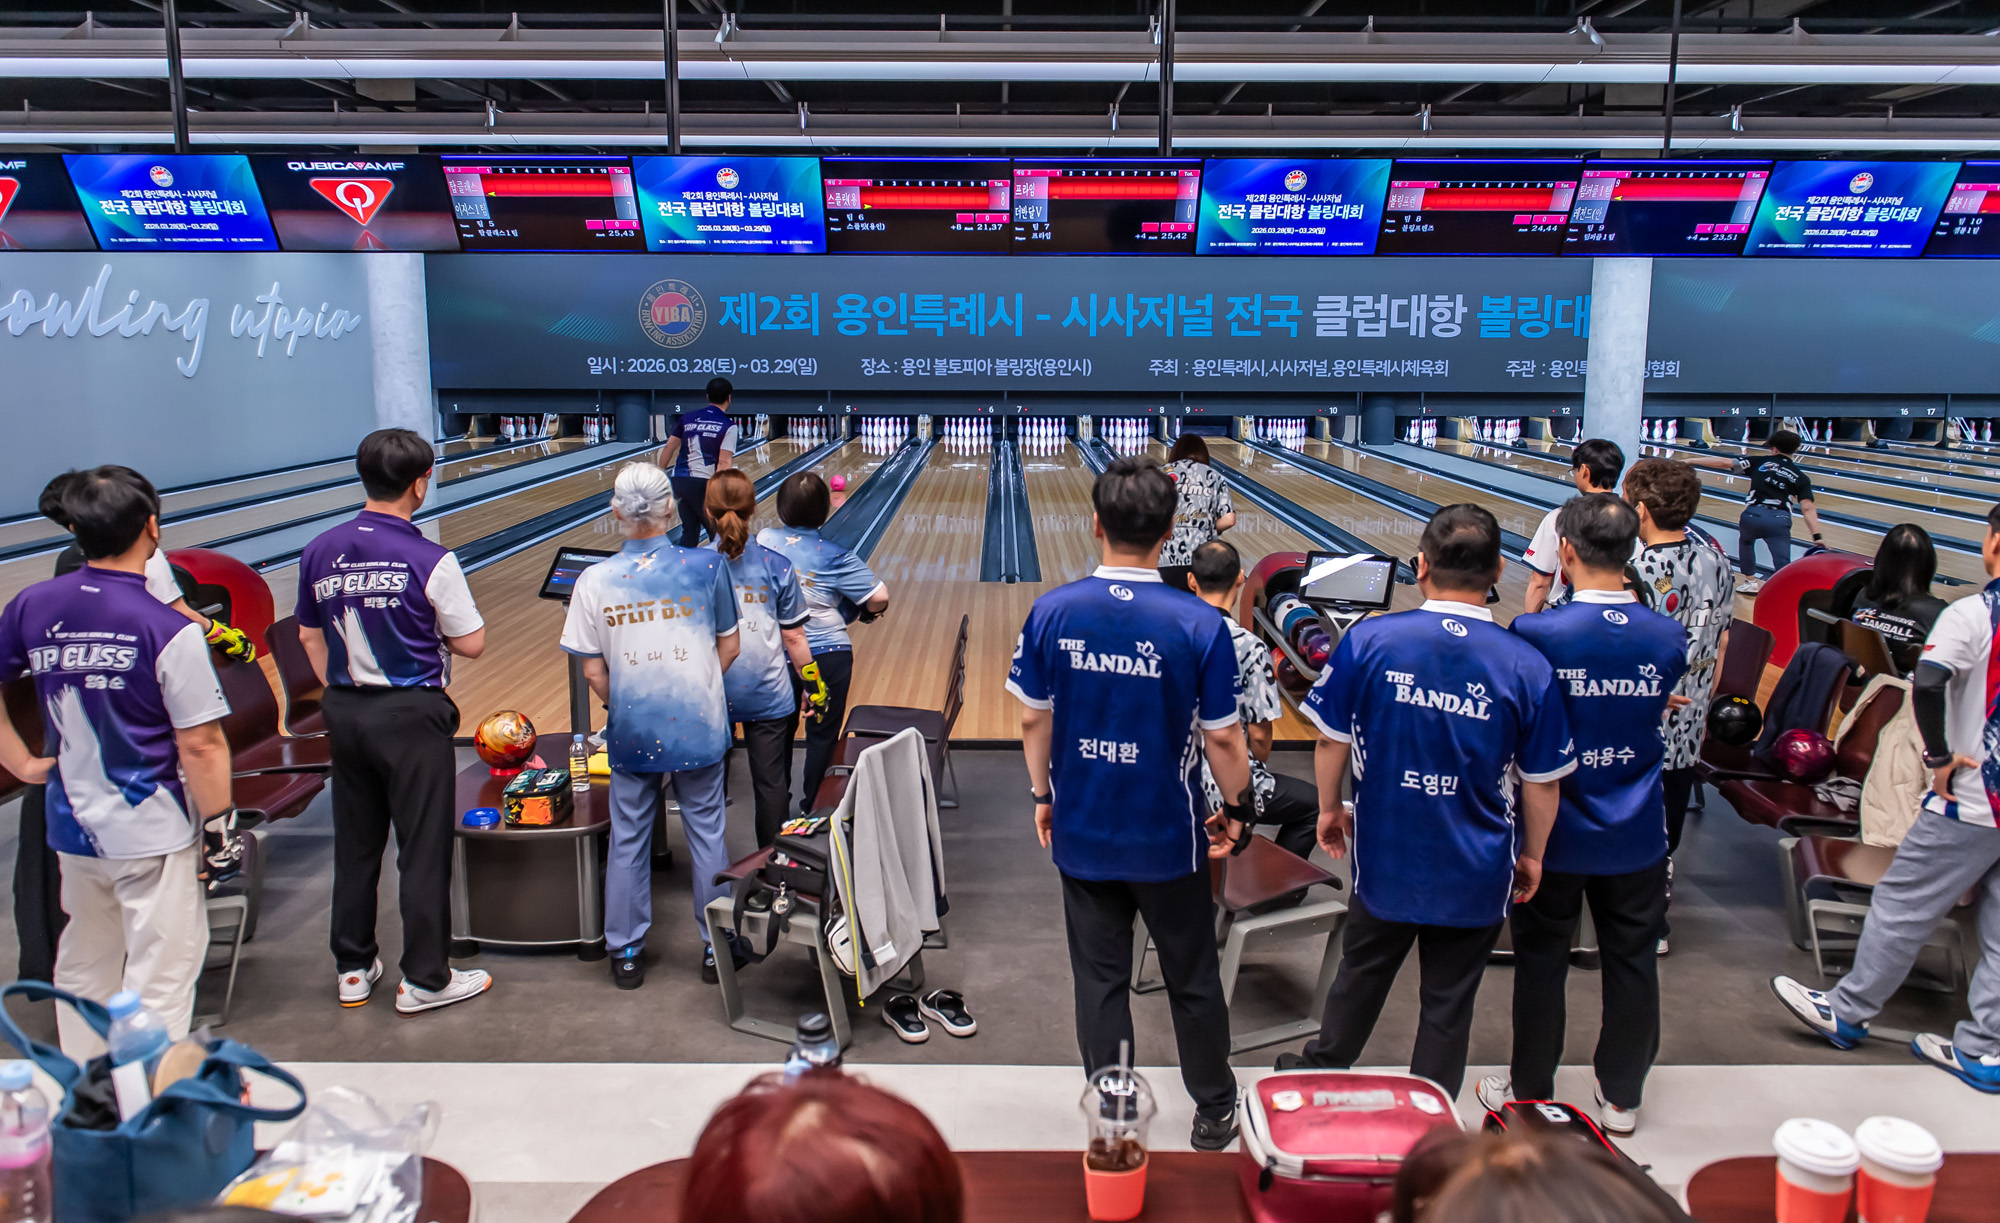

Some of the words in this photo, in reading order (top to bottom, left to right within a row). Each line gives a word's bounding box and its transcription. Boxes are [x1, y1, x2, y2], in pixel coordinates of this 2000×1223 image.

[0, 160, 27, 170] MF
[287, 162, 358, 171] QUBICA
[364, 162, 405, 171] AMF
[682, 191, 704, 200] 제2회
[705, 192, 743, 201] 용인특례시
[748, 192, 779, 201] 시사저널
[1015, 183, 1036, 197] 프라임
[1245, 194, 1267, 203] 제2회
[1268, 194, 1306, 203] 용인특례시
[1312, 194, 1342, 203] 시사저널
[99, 200, 130, 215] 전국
[131, 200, 187, 215] 클럽대항
[189, 200, 248, 215] 볼링대회
[658, 202, 686, 217] 전국
[689, 202, 745, 217] 클럽대항
[748, 203, 805, 218] 볼링대회
[1218, 204, 1247, 219] 전국
[1249, 204, 1305, 219] 클럽대항
[1307, 204, 1364, 219] 볼링대회
[1774, 206, 1805, 221] 전국
[1805, 206, 1863, 222] 클럽대항
[1864, 207, 1922, 222] 볼링대회
[0, 263, 210, 378] owling
[230, 281, 362, 358] utopia
[655, 306, 691, 323] YIBA
[718, 292, 820, 336] 제2회
[832, 292, 1023, 337] 용인특례시
[1061, 293, 1214, 337] 시사저널
[1225, 294, 1303, 338] 전국
[1312, 294, 1468, 338] 클럽대항
[1476, 295, 1592, 338] 볼링대
[587, 357, 617, 375] 일시
[860, 358, 892, 376] 장소
[900, 358, 931, 376] 용인
[933, 358, 992, 376] 볼토피아
[994, 358, 1092, 378] 볼링장(용인시)
[1148, 359, 1179, 377] 주최
[1505, 360, 1536, 378] 주관
[675, 405, 681, 413] 3
[817, 405, 823, 413] 4
[846, 405, 851, 413] 5
[988, 405, 994, 413] 6
[1016, 406, 1022, 414] 7
[1159, 406, 1165, 414] 8
[1185, 406, 1191, 414] 9
[1329, 407, 1338, 415] 10
[1561, 407, 1571, 415] 12
[1731, 407, 1740, 416] 14
[1758, 407, 1767, 416] 15
[1900, 407, 1909, 416] 16
[1926, 407, 1936, 417] 17
[697, 423, 723, 433] CLASS
[1177, 478, 1212, 498] rime
[312, 575, 342, 603] TOP
[343, 571, 409, 593] CLASS
[603, 602, 655, 628] SPLIT
[662, 596, 694, 620] B.C
[1674, 596, 1722, 628] rime
[1861, 618, 1914, 638] JAMBALL
[1058, 638, 1086, 652] THE
[60, 643, 139, 672] CLASS
[1069, 652, 1162, 678] BANDAL
[1385, 670, 1414, 686] THE
[1557, 668, 1587, 680] THE
[1569, 679, 1662, 697] BANDAL
[1395, 684, 1491, 721] BANDAL
[1078, 738, 1140, 764] 전대환
[1581, 747, 1635, 770] 하용수
[1401, 769, 1459, 796] 도영민
